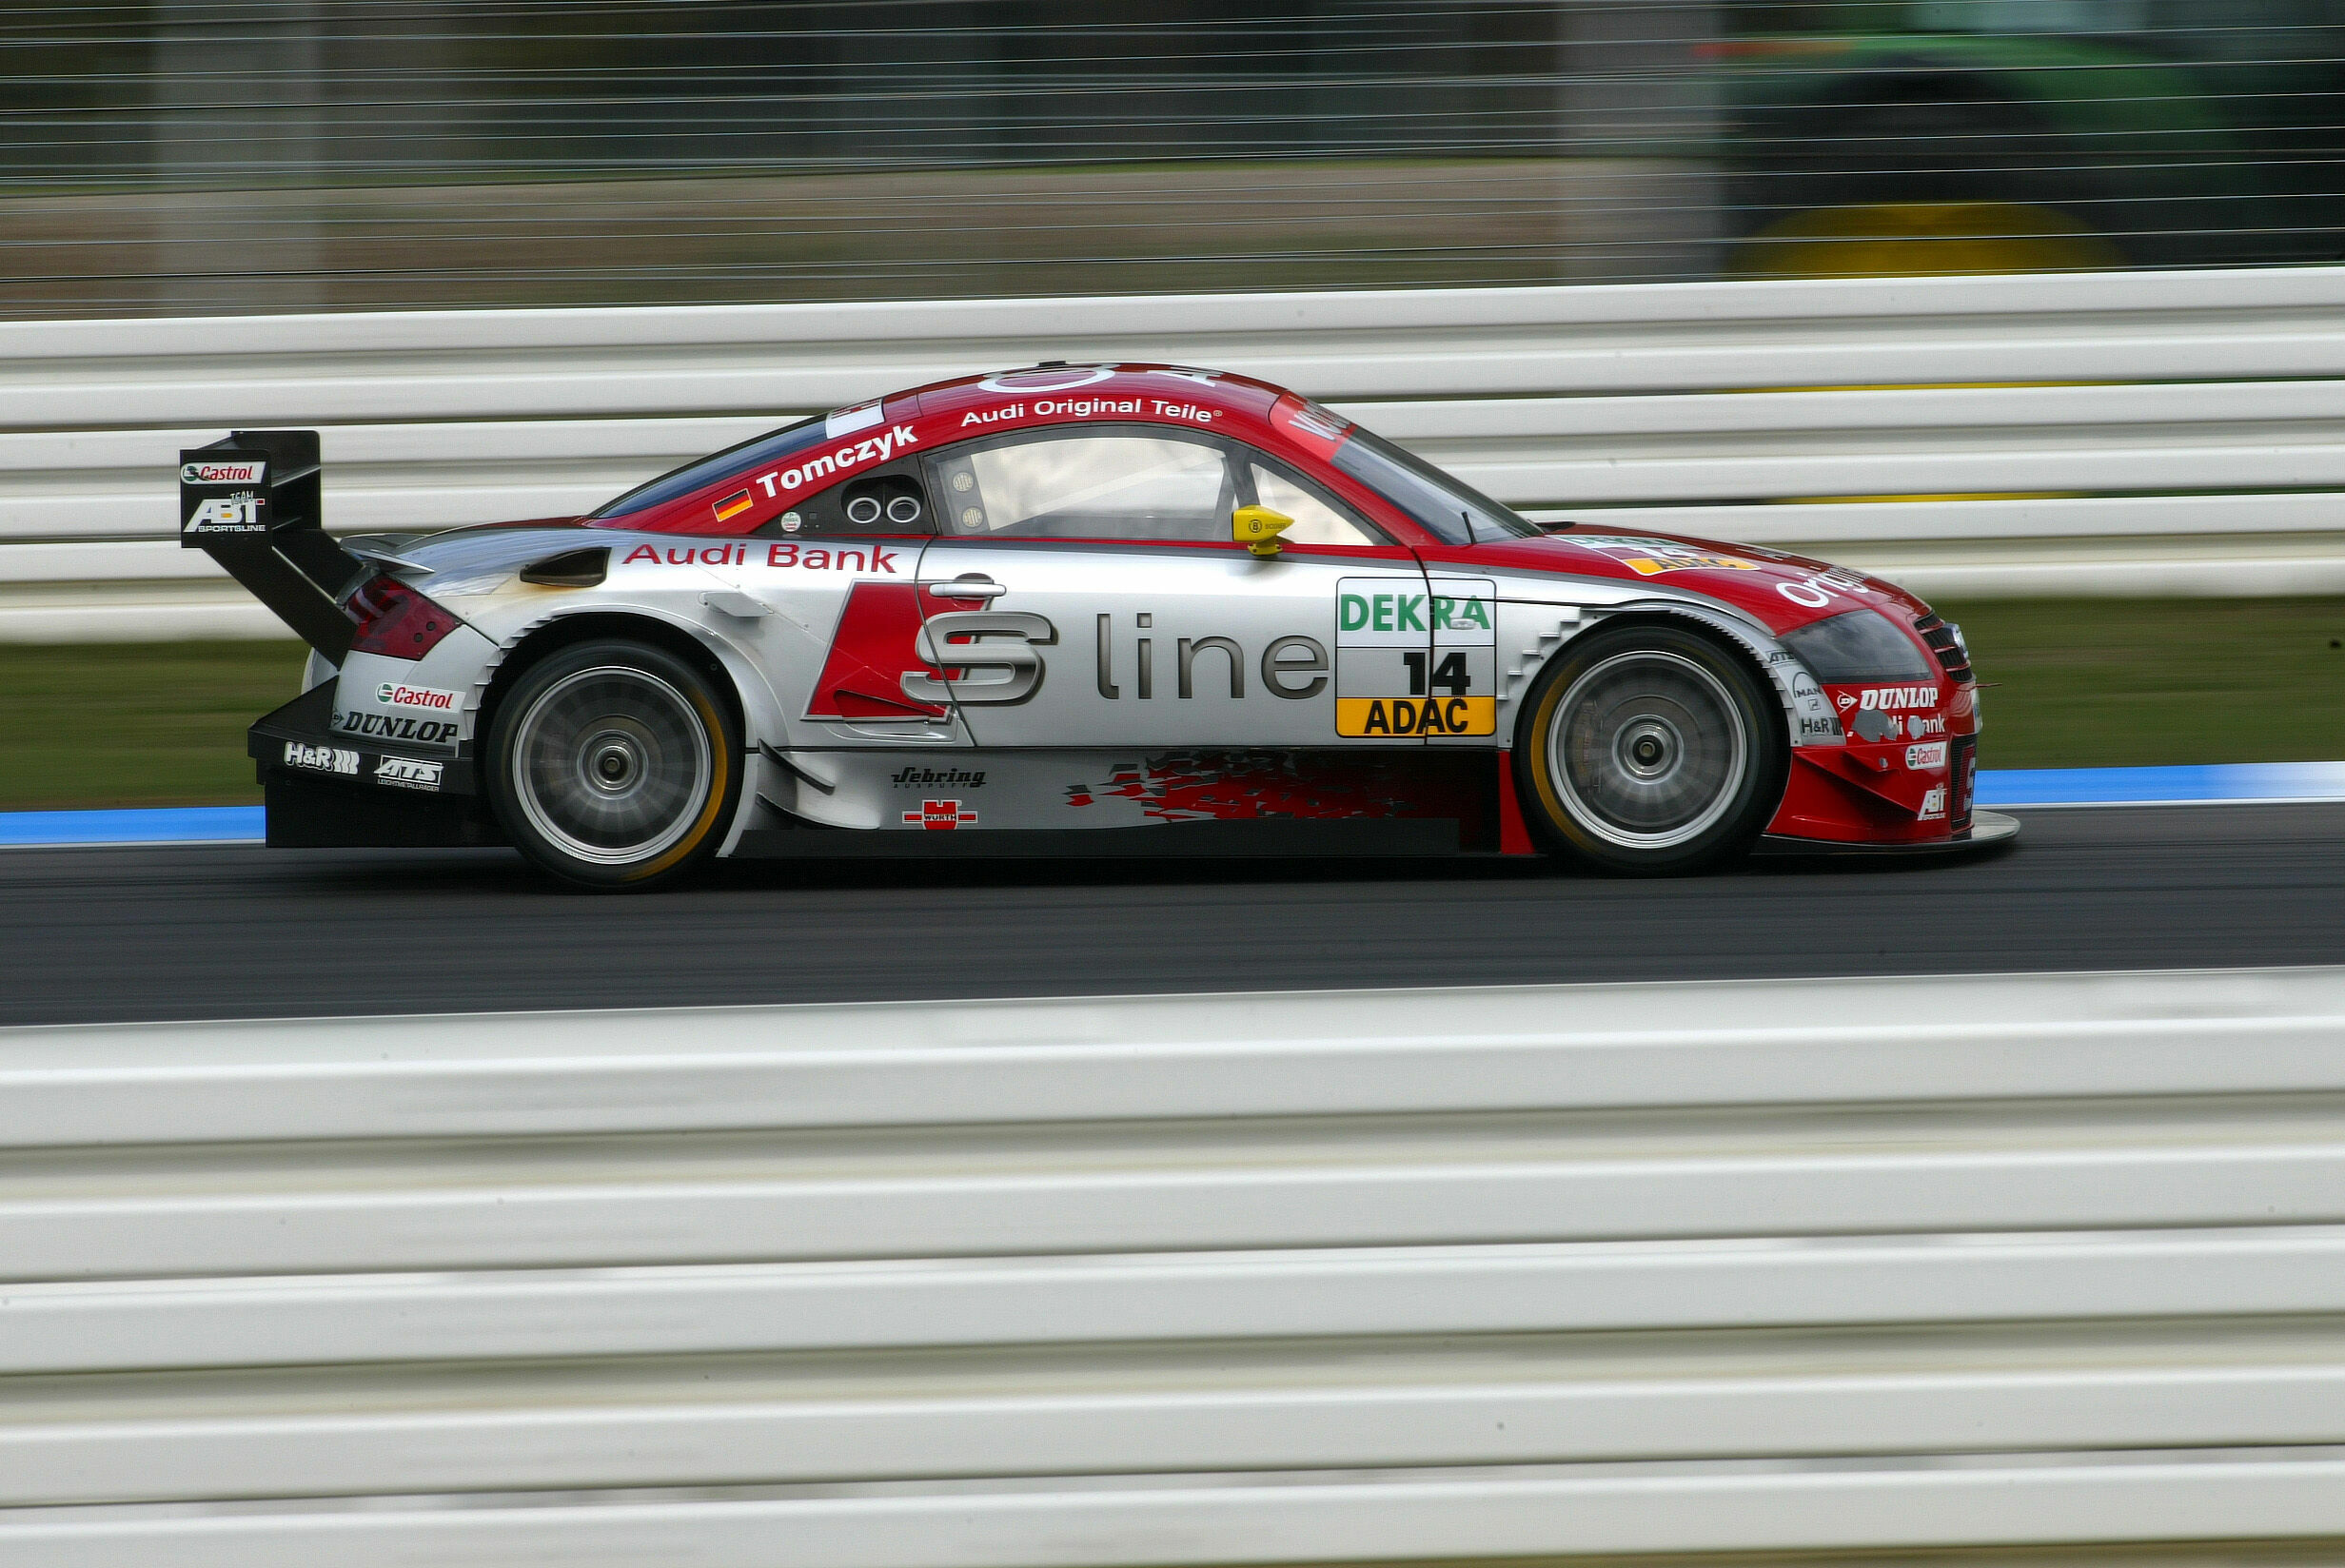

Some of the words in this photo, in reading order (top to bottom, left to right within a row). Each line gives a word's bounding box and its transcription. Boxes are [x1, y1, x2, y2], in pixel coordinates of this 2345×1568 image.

[961, 402, 1025, 428] Audi
[1033, 397, 1142, 419] Original
[200, 465, 253, 481] Castrol
[756, 423, 919, 499] Tomczyk
[182, 498, 266, 533] ABT
[621, 542, 747, 566] Audi
[766, 543, 899, 574] Bank
[1340, 593, 1491, 632] DEKRA
[900, 610, 1058, 707] S
[1095, 612, 1330, 700] line
[1403, 652, 1471, 696] 14
[393, 686, 454, 710] Castrol
[1860, 687, 1939, 711] DUNLOP
[343, 711, 459, 744] DUNLOP
[1363, 697, 1468, 735] ADAC
[1801, 717, 1830, 735] H&R
[284, 741, 333, 771] H&R
[373, 759, 444, 781] ATS
[891, 766, 987, 788] Sebring
